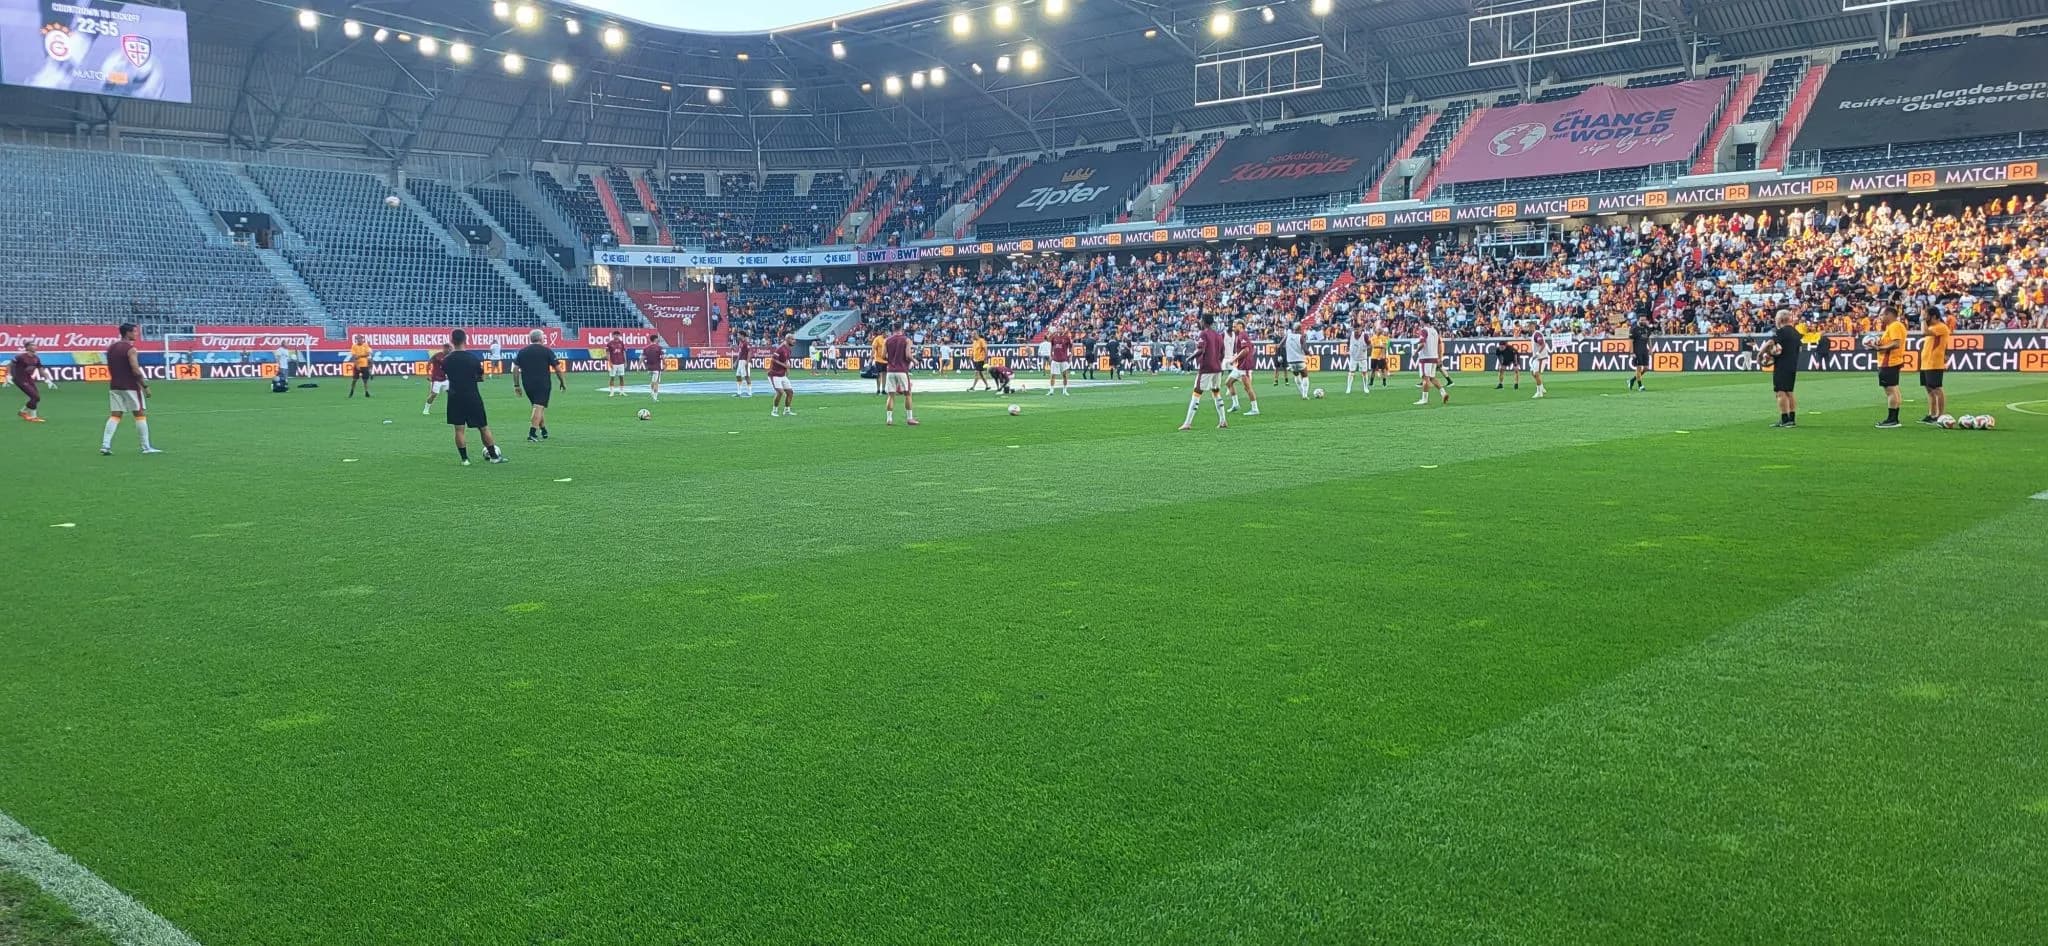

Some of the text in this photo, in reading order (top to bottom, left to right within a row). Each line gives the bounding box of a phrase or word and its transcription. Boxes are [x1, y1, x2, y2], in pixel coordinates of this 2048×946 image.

[77, 16, 119, 36] 22:55
[1839, 81, 2048, 109] Raiffeisenlandesban
[1552, 107, 1677, 132] CHANGE
[1570, 122, 1670, 143] WORLD
[1218, 157, 1361, 184] Kornspitz
[1945, 166, 2007, 184] MATCH
[1850, 174, 1907, 190] MATCH
[1675, 188, 1724, 203] MATCH
[1758, 181, 1811, 197] MATCH
[1016, 183, 1111, 212] Zipfer
[1599, 194, 1644, 209] MATCH
[1457, 206, 1497, 219] MATCH
[1524, 200, 1567, 214] MATCH
[1333, 215, 1368, 228] MATCH
[1394, 211, 1432, 224] MATCH
[1224, 224, 1255, 236] MATCH
[1277, 220, 1310, 232] MATCH
[1081, 235, 1108, 246] MATCH
[1126, 232, 1153, 242] MATCH
[1173, 228, 1201, 240] MATCH
[997, 241, 1021, 251] MATCH
[1037, 238, 1063, 249] MATCH
[867, 251, 886, 261] BWT
[897, 248, 918, 260] BWT
[644, 303, 700, 313] Kornspitz
[0, 332, 121, 351] Original Kornspi
[202, 333, 256, 350] Original
[413, 333, 450, 346] BACKEN
[472, 333, 548, 346] VERANTWORTG
[1309, 345, 1338, 355] ATCH
[1454, 343, 1500, 354] MATC
[572, 360, 607, 371] MATCH
[685, 359, 716, 369] MATCH
[1465, 356, 1482, 369] PR
[1556, 356, 1575, 369] PR
[1658, 356, 1679, 369] PR
[1694, 354, 1760, 370] MATCH
[1944, 352, 2018, 370] MATCH
[89, 366, 108, 379] PR
[139, 366, 175, 379] ATCH
[211, 365, 260, 378] MATCH
[295, 364, 342, 376] MATCH
[371, 362, 415, 375] MATCH
